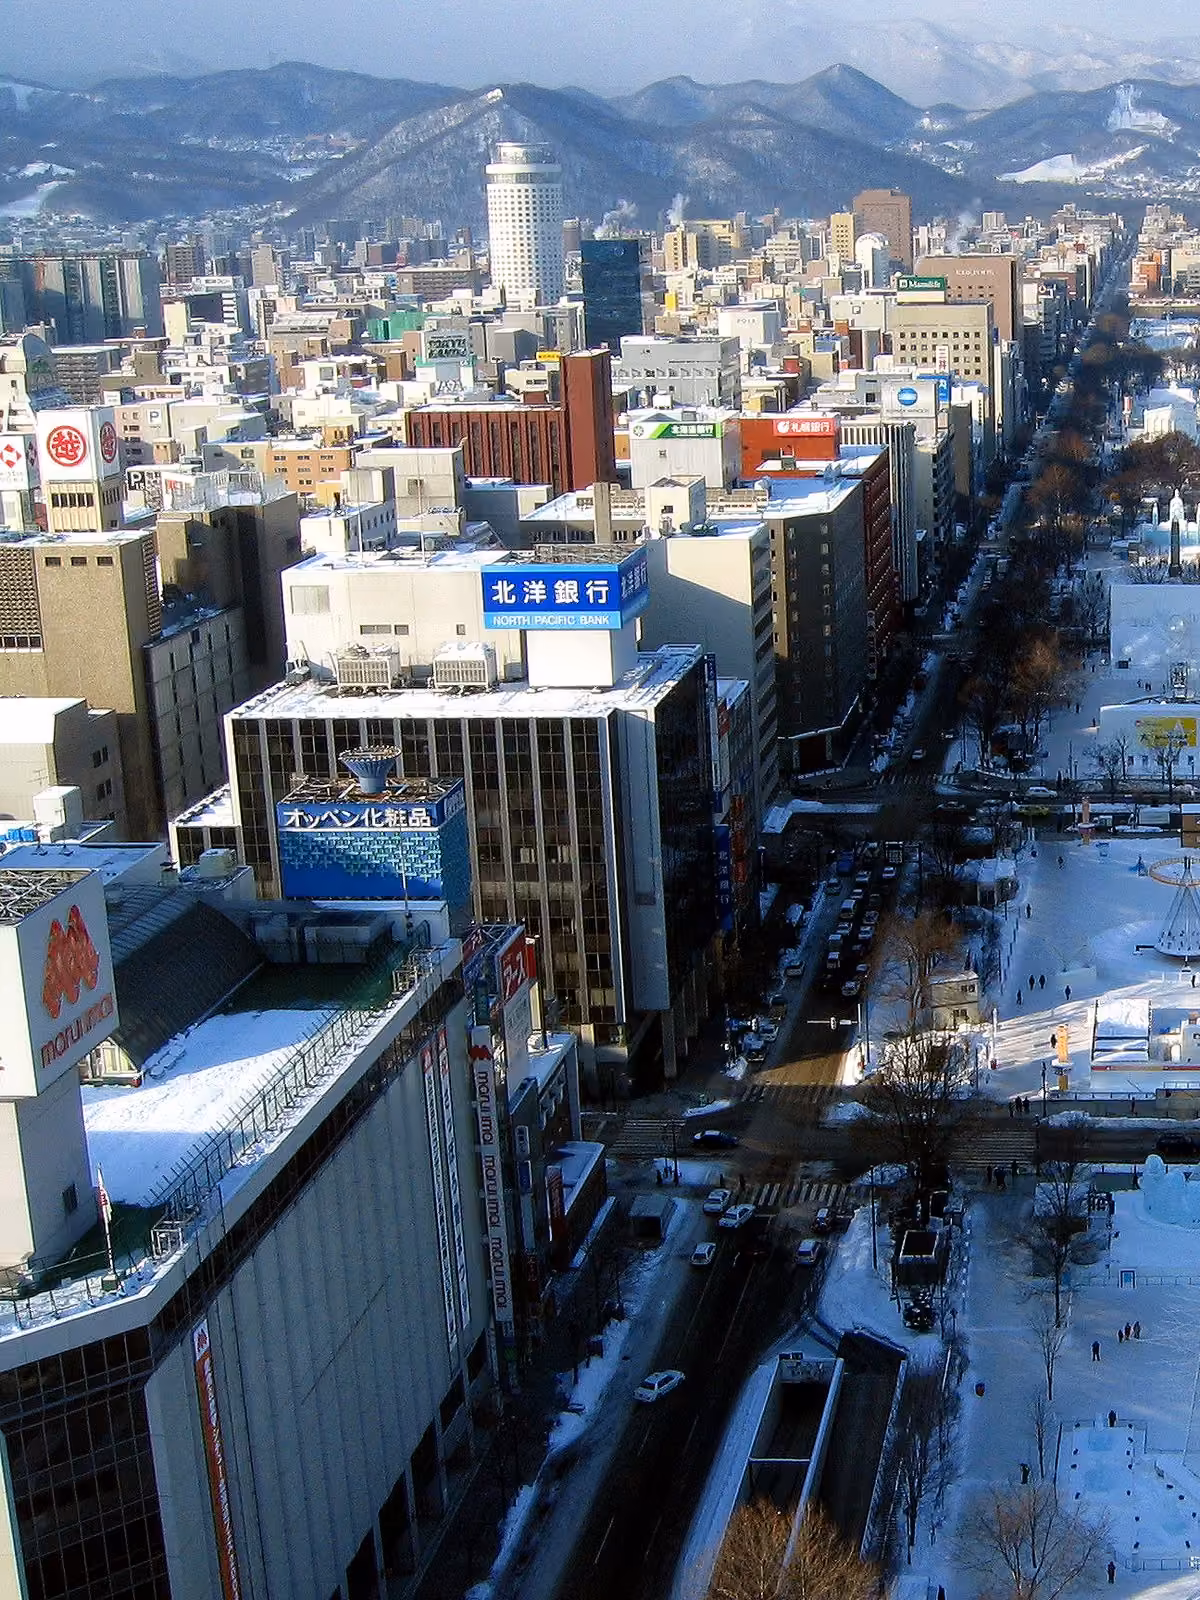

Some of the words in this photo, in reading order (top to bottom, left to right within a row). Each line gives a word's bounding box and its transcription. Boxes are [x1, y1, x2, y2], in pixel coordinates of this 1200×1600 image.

[149, 411, 159, 422] P
[130, 471, 142, 487] P
[491, 579, 610, 605] 北洋銀行
[493, 615, 531, 626] NORTH
[535, 615, 576, 626] PACIFIC
[580, 615, 610, 626] BANK
[283, 807, 432, 829] オッペン化粧品
